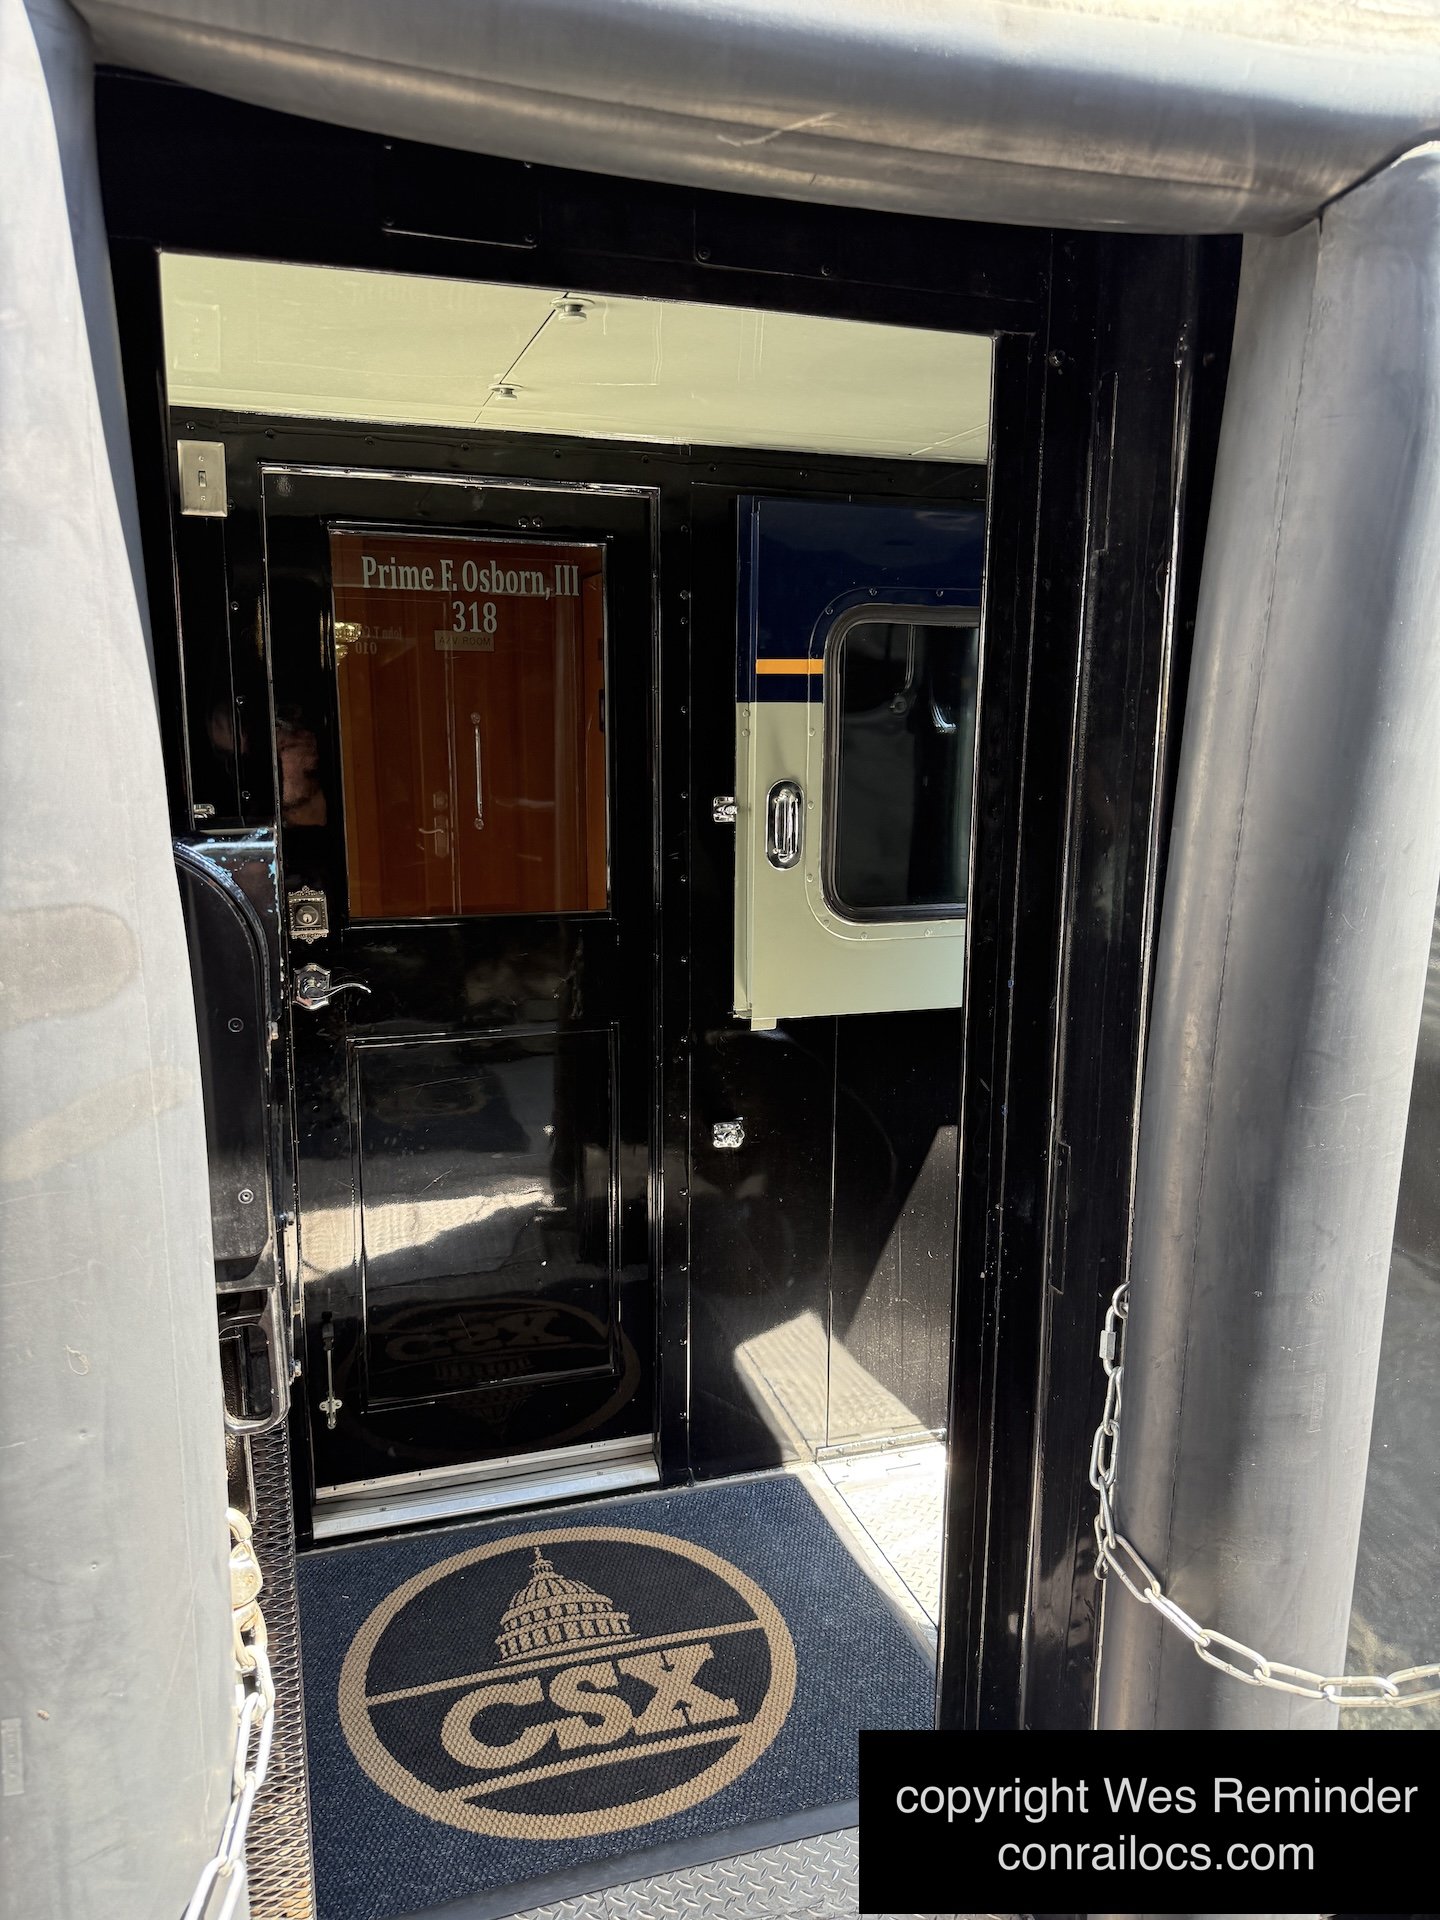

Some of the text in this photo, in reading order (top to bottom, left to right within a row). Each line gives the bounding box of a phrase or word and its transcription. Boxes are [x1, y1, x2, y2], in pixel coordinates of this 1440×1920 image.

[361, 556, 580, 600] Prime F. Osborn, III
[452, 600, 497, 633] 318
[462, 637, 491, 646] ROOM
[440, 1642, 740, 1769] CSX
